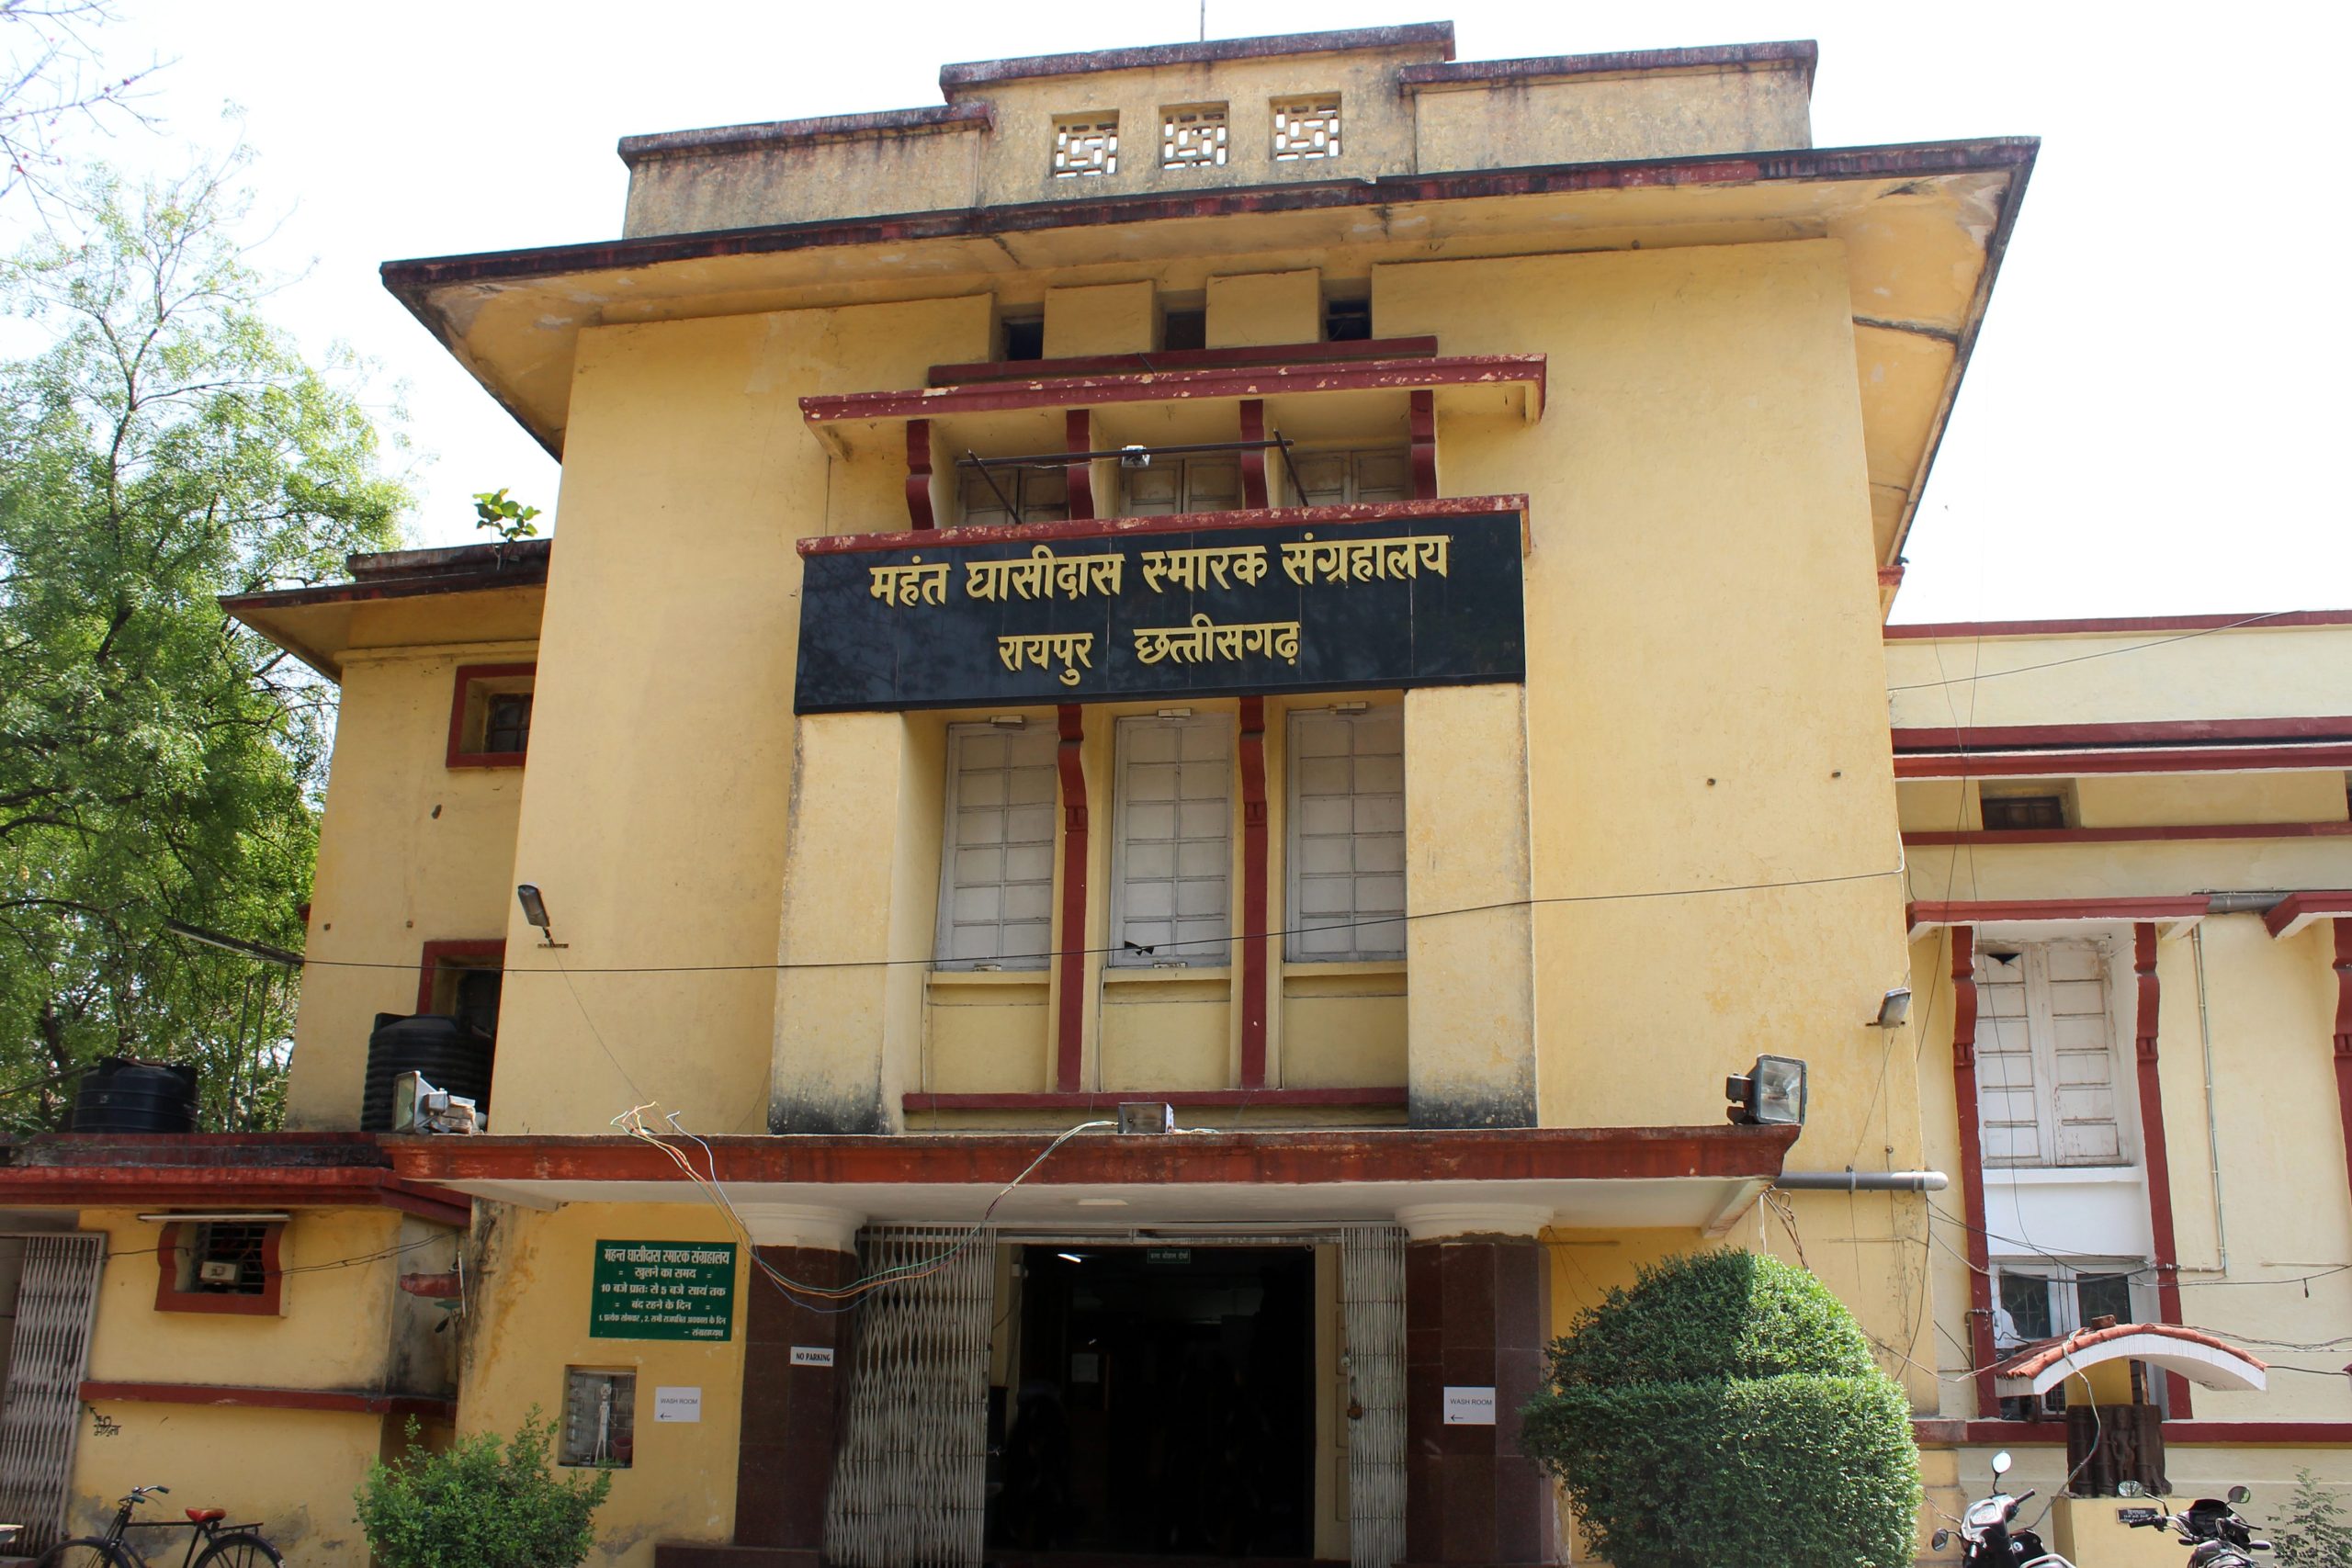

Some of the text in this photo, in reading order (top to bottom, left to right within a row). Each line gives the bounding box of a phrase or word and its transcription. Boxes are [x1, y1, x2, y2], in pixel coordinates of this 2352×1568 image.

[869, 532, 1453, 607] महंत घासीदास स्मारक संग्रहालय
[997, 613, 1302, 687] रायपुर छत्तीसगढ़
[628, 1245, 662, 1263] घासीदास
[662, 1249, 690, 1263] स्मारक
[691, 1247, 730, 1265] संग्रहालय
[634, 1265, 697, 1280] खुलने का समय
[613, 1281, 628, 1293] बजे
[650, 1283, 660, 1294] से
[661, 1286, 667, 1295] 5
[669, 1283, 684, 1295] बजे
[709, 1286, 727, 1297] तक
[631, 1298, 692, 1311] बंद रहने के दिन
[796, 1351, 831, 1362] NO PARKING
